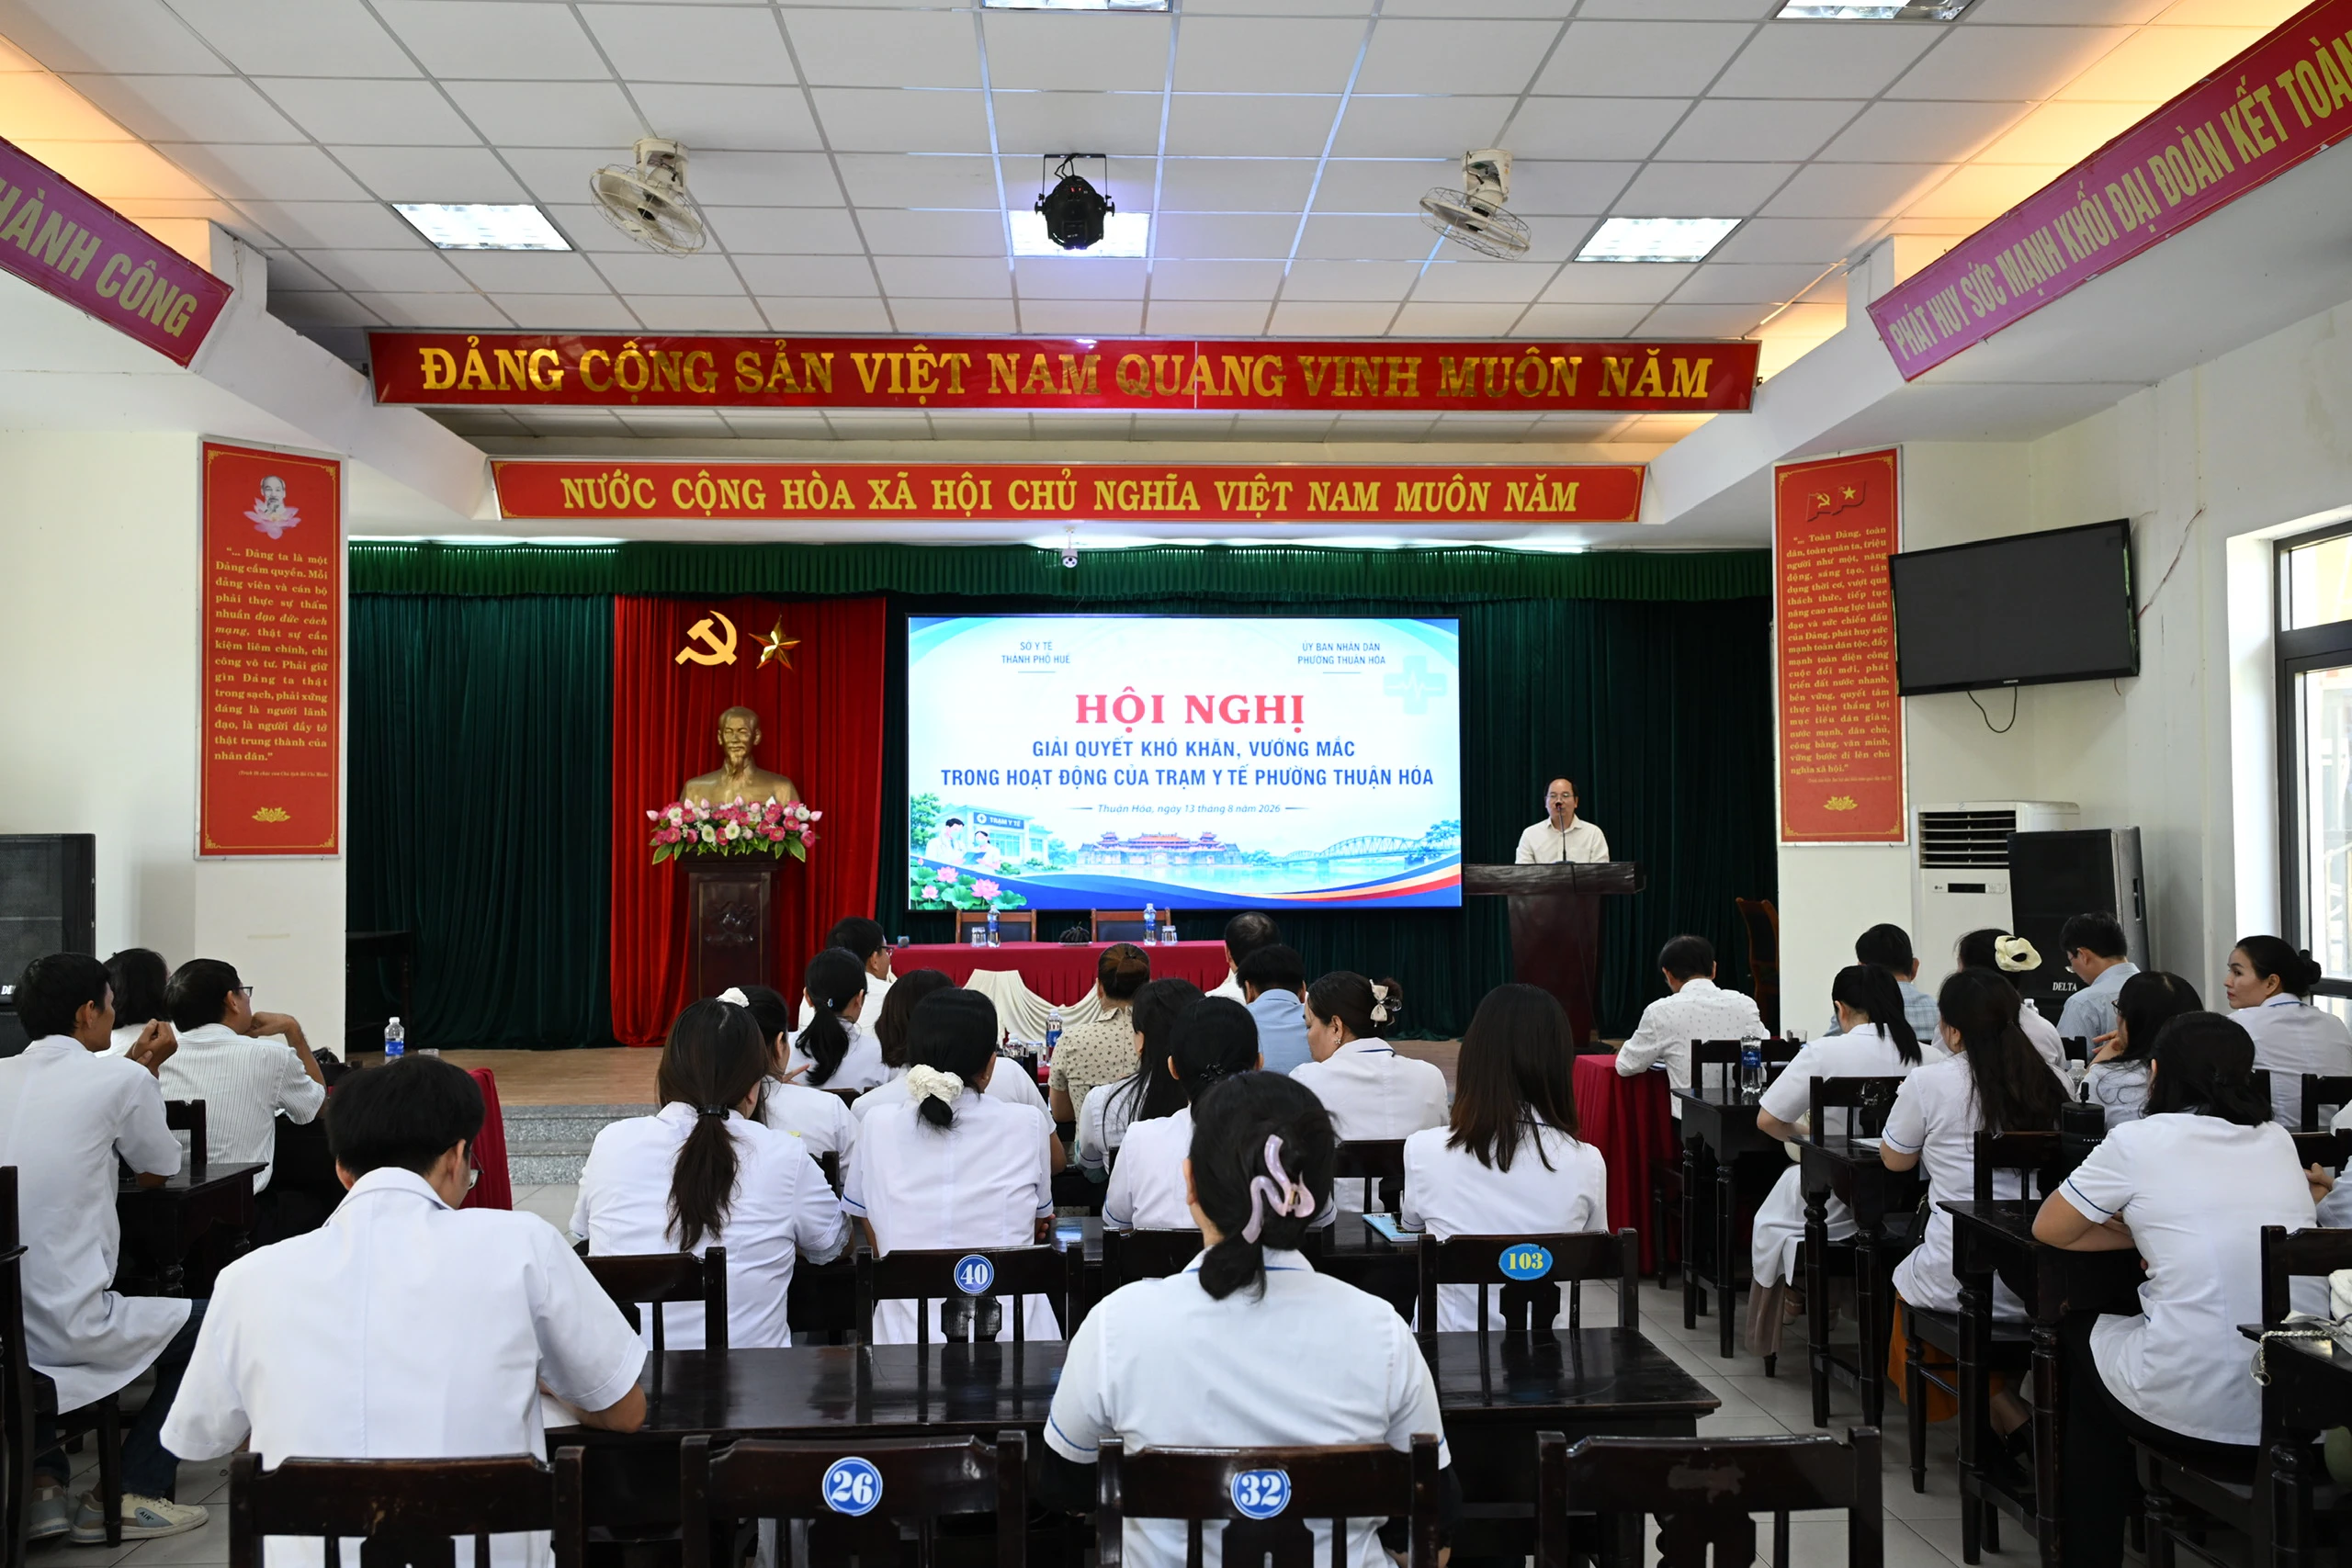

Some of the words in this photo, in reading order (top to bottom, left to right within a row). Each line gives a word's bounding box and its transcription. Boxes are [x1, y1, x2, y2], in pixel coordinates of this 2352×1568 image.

[1888, 304, 1938, 361] PHÁT
[1926, 285, 1971, 338] HUY
[1960, 262, 2007, 318] SỨC
[1995, 226, 2067, 297] MẠNH
[2052, 180, 2120, 264] KHỐI
[2105, 166, 2162, 233] ĐẠI
[2147, 125, 2235, 208] ĐOÀN
[2220, 75, 2289, 164] KẾT
[96, 254, 198, 338] CÔNG
[420, 334, 564, 391] ĐẢNG
[578, 340, 718, 403] CỘNG
[734, 339, 834, 395] SẢN
[850, 344, 971, 404] VIỆT
[988, 354, 1101, 396] NAM
[1115, 355, 1285, 398] QUANG
[1297, 355, 1419, 397] VINH
[1437, 346, 1583, 398] MUÔN
[1599, 348, 1713, 398] NĂM
[561, 468, 655, 510] NƯỚC
[671, 469, 765, 516] CỘNG
[782, 470, 855, 511] HÒA
[867, 471, 917, 511] XÃ
[932, 471, 992, 517] HỘI
[1008, 467, 1077, 511] CHỦ
[1094, 472, 1201, 512] NGHĨA
[1215, 474, 1293, 519] VIỆT
[1306, 481, 1380, 512] NAM
[1394, 473, 1488, 512] MUÔN
[1503, 474, 1580, 513] NĂM
[245, 548, 274, 561] Đảng
[278, 553, 288, 561] ta
[293, 553, 303, 562] là
[308, 556, 328, 565] một
[247, 581, 271, 591] viên
[275, 583, 288, 592] và
[292, 584, 311, 593] cán
[315, 586, 328, 596] bộ
[216, 593, 241, 604] phải
[249, 595, 274, 607] thực
[280, 600, 294, 609] sự
[300, 600, 328, 610] thấm
[279, 614, 300, 624] đức
[303, 616, 327, 626] cách
[215, 626, 250, 637] mạng,
[257, 627, 281, 638] thật
[288, 631, 301, 640] sự
[215, 639, 243, 650] kiệm
[247, 642, 271, 652] liêm
[275, 644, 308, 655] chính,
[1035, 642, 1040, 650] Y
[1317, 642, 1333, 651] BAN
[1336, 641, 1360, 651] NHÂN
[215, 657, 242, 668] công
[245, 659, 259, 667] vô
[264, 660, 277, 668] tư.
[282, 660, 307, 670] Phải
[215, 672, 234, 682] gìn
[243, 673, 276, 685] Đảng
[283, 676, 294, 684] ta
[302, 677, 327, 687] thật
[215, 689, 245, 699] trong
[276, 691, 300, 702] phải
[214, 704, 243, 715] đáng
[250, 705, 259, 714] là
[267, 707, 297, 716] người
[1076, 686, 1165, 733] HỘI
[1184, 694, 1305, 733] NGHỊ
[214, 719, 238, 730] đạo,
[243, 720, 253, 729] là
[258, 721, 288, 732] người
[215, 735, 237, 746] thật
[241, 737, 271, 747] trung
[274, 738, 305, 747] thành
[308, 738, 327, 747] của
[1033, 736, 1069, 757] GIẢI
[1076, 735, 1133, 758] QUYẾT
[1141, 737, 1178, 756] KHÓ
[1186, 737, 1241, 760] KHĂN,
[1250, 737, 1308, 757] VƯỚNG
[1317, 735, 1355, 757] MẮC
[214, 750, 243, 761] nhân
[941, 769, 1000, 785] TRONG
[1007, 769, 1053, 790] HOẠT
[1058, 765, 1107, 790] ĐỘNG
[1114, 764, 1149, 785] CỦA
[1156, 769, 1205, 790] TRẠM
[1212, 770, 1222, 784] Y
[1227, 763, 1249, 785] TẾ
[1255, 765, 1327, 785] PHƯỜNG
[1334, 765, 1391, 789] THUẬN
[1398, 765, 1433, 784] HÓA
[1158, 805, 1182, 815] ngày
[1184, 804, 1194, 813] 13
[1197, 804, 1226, 815] tháng
[1227, 804, 1234, 813] 8
[1259, 804, 1281, 813] 2026
[2052, 982, 2076, 992] DELTA
[1507, 1252, 1544, 1269] 103
[960, 1264, 989, 1285] 40
[830, 1470, 873, 1505] 26
[1240, 1474, 1281, 1506] 32
[139, 1511, 153, 1521] AIR
